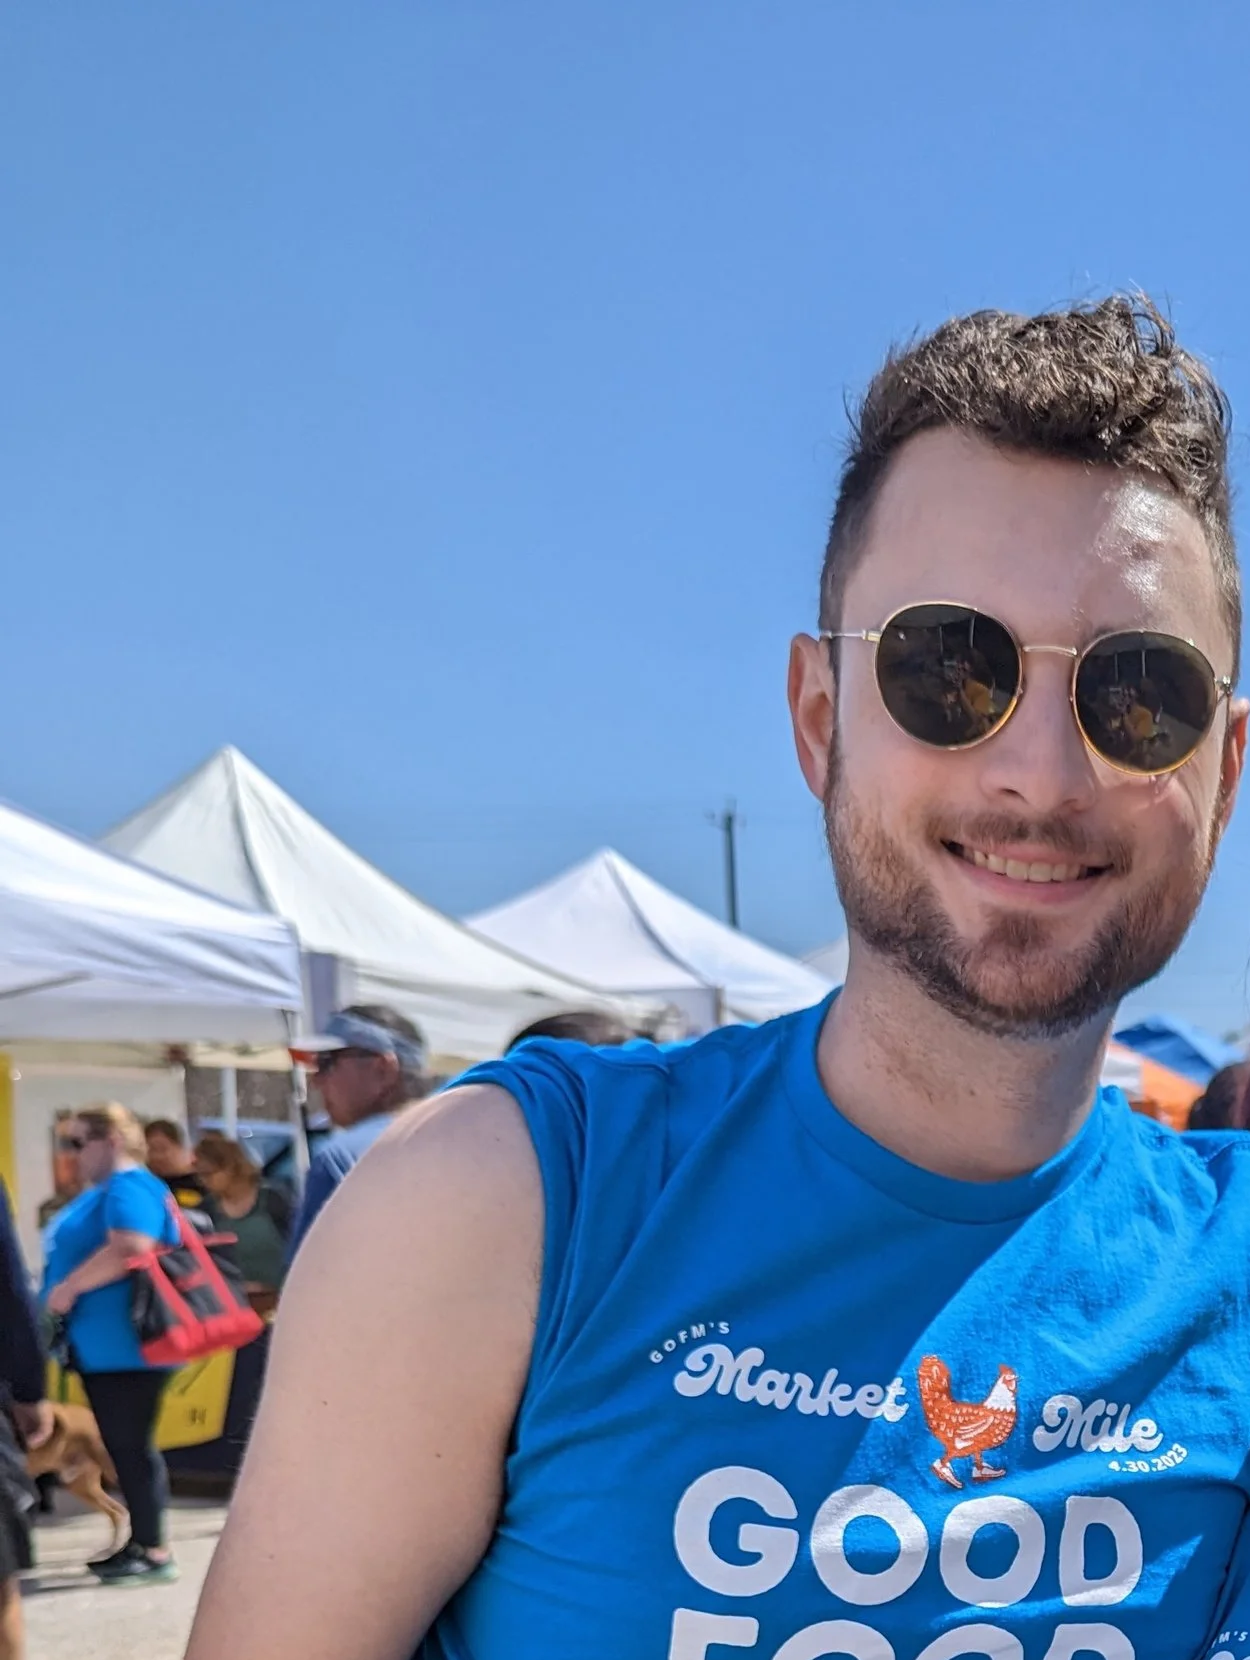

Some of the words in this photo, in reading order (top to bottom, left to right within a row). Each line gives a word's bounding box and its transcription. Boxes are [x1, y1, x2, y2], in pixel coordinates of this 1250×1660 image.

[649, 1321, 731, 1364] GOFM'S
[673, 1343, 909, 1423] Market
[1032, 1394, 1164, 1453] Mile
[1108, 1443, 1188, 1473] 4.30.2023
[673, 1465, 1144, 1608] GOOD
